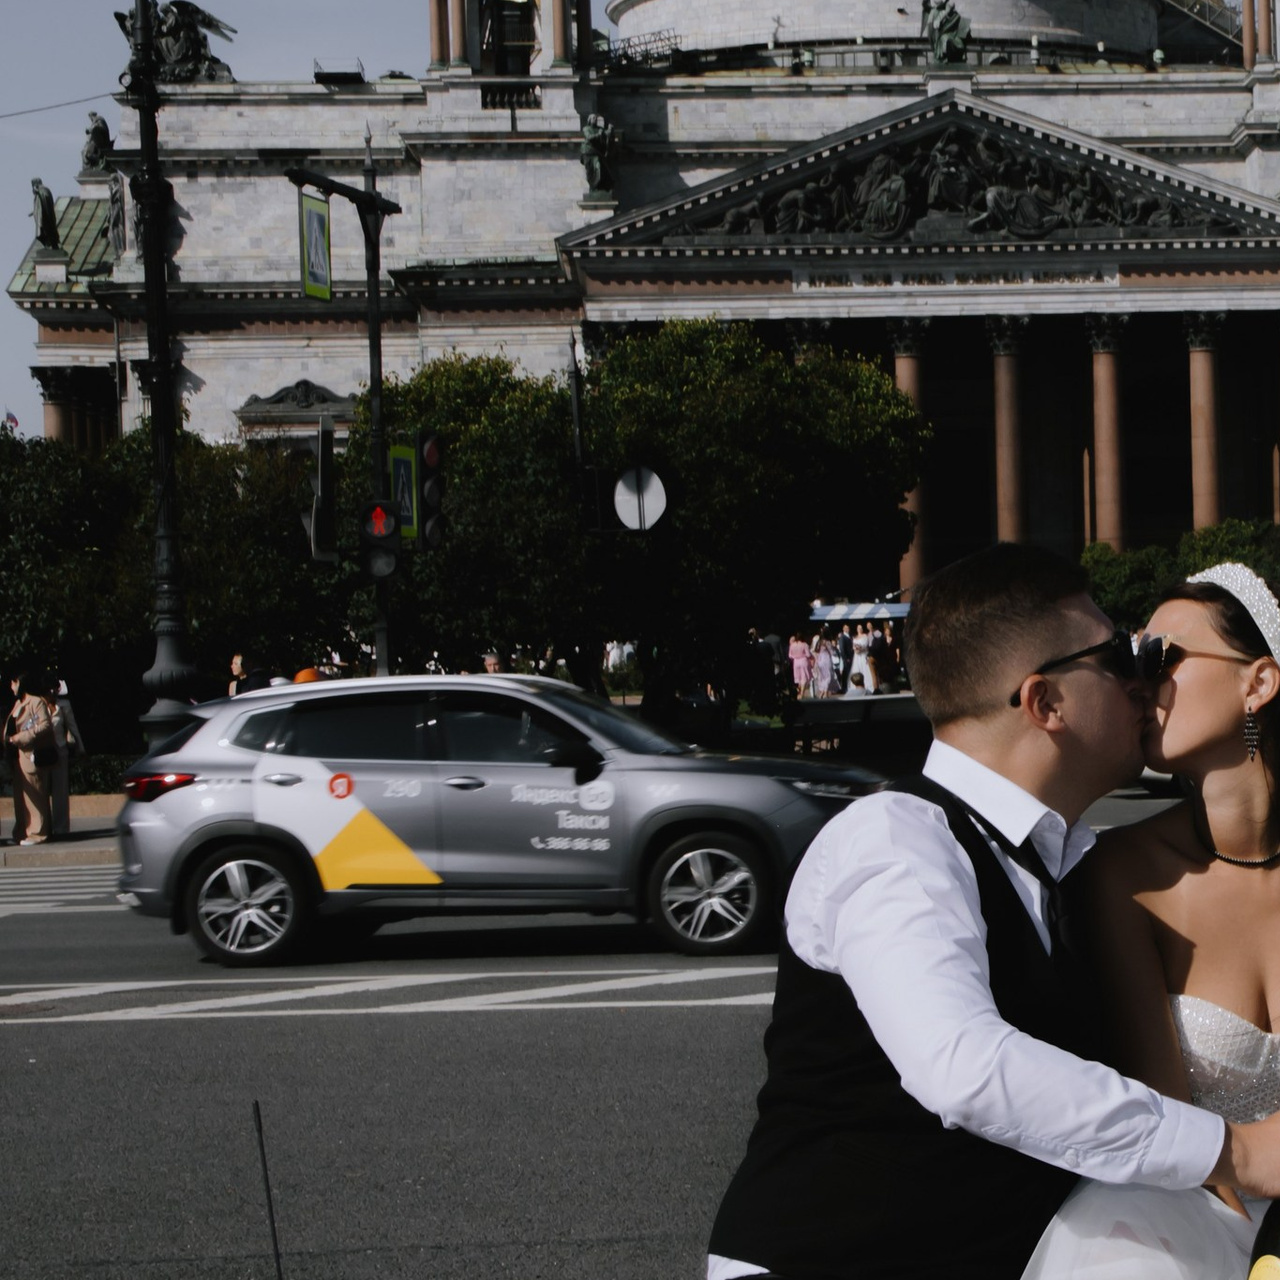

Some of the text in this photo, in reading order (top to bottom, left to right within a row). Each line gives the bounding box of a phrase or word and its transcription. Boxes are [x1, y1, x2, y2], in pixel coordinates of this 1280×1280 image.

[332, 778, 348, 797] Я
[510, 783, 580, 805] Яндекс
[555, 809, 610, 830] Такси
